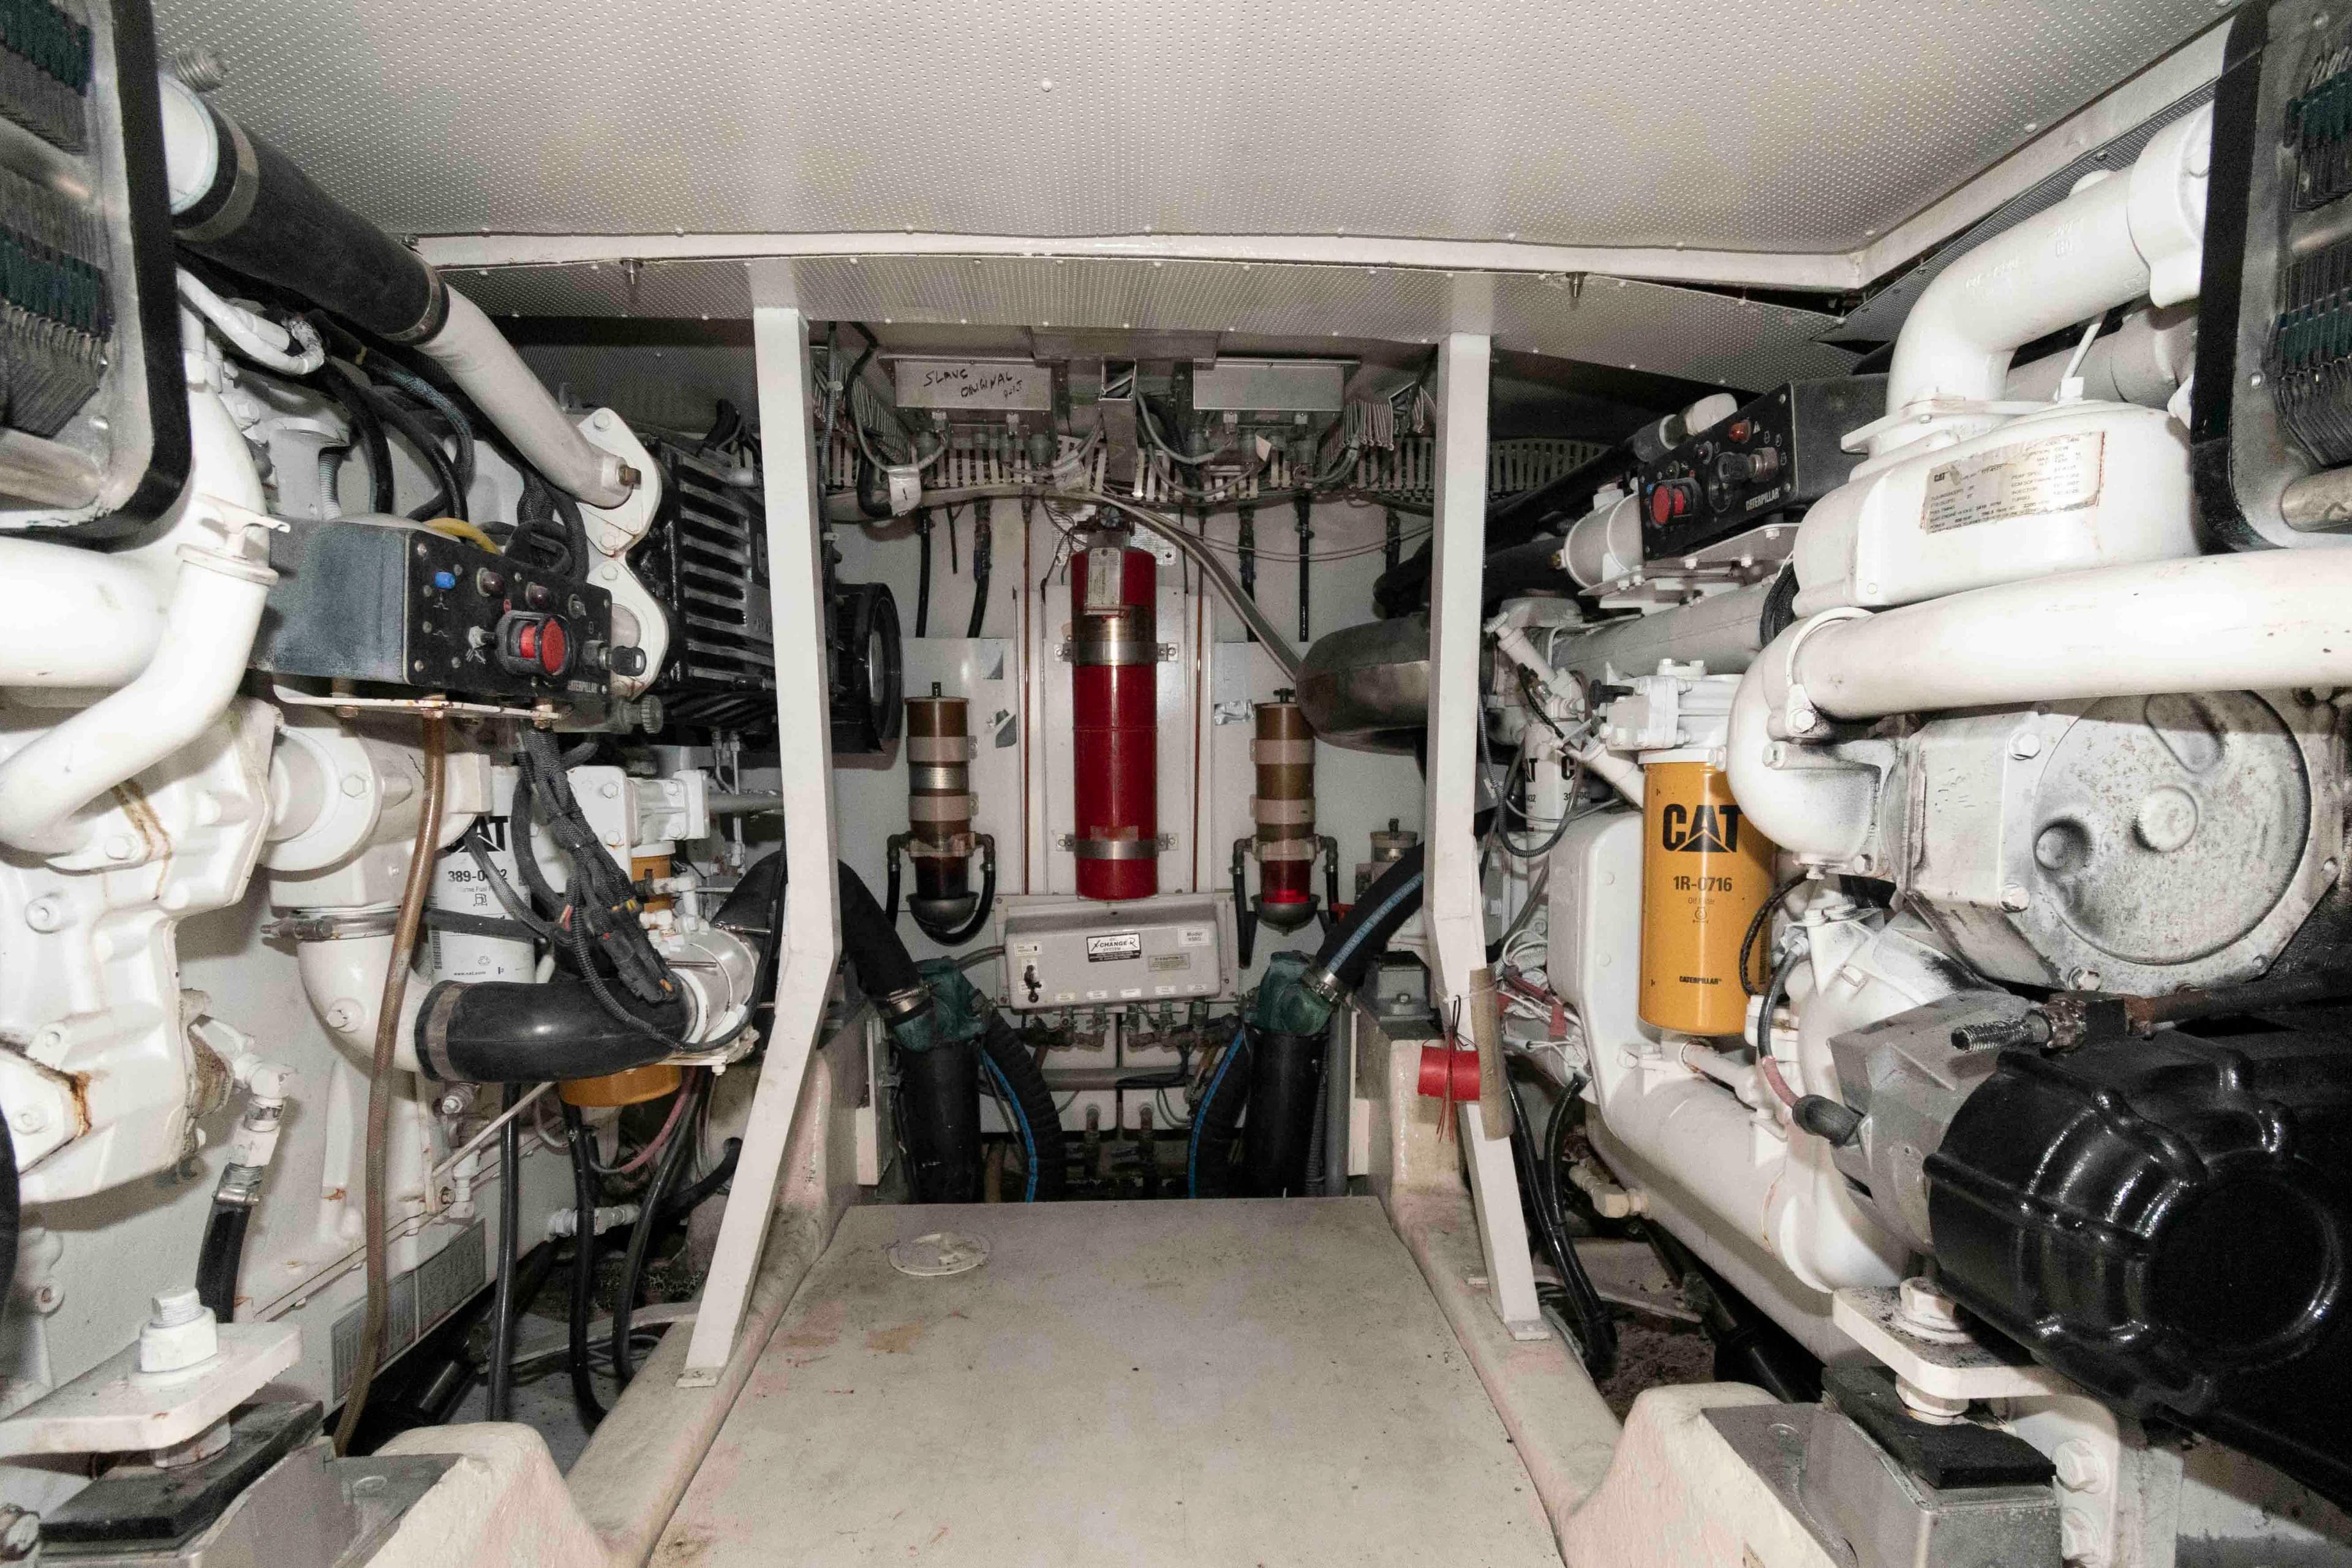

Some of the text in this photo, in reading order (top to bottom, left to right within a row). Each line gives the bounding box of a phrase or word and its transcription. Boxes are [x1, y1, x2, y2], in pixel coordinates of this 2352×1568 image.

[1934, 472, 1946, 482] CAT
[1745, 488, 1779, 511] CATERPILLAR
[443, 815, 508, 853] AT
[1662, 804, 1743, 853] CAT
[448, 869, 508, 883] 389-02
[1673, 876, 1732, 892] 1R-0716
[1679, 976, 1719, 985] CATERPILLAR
